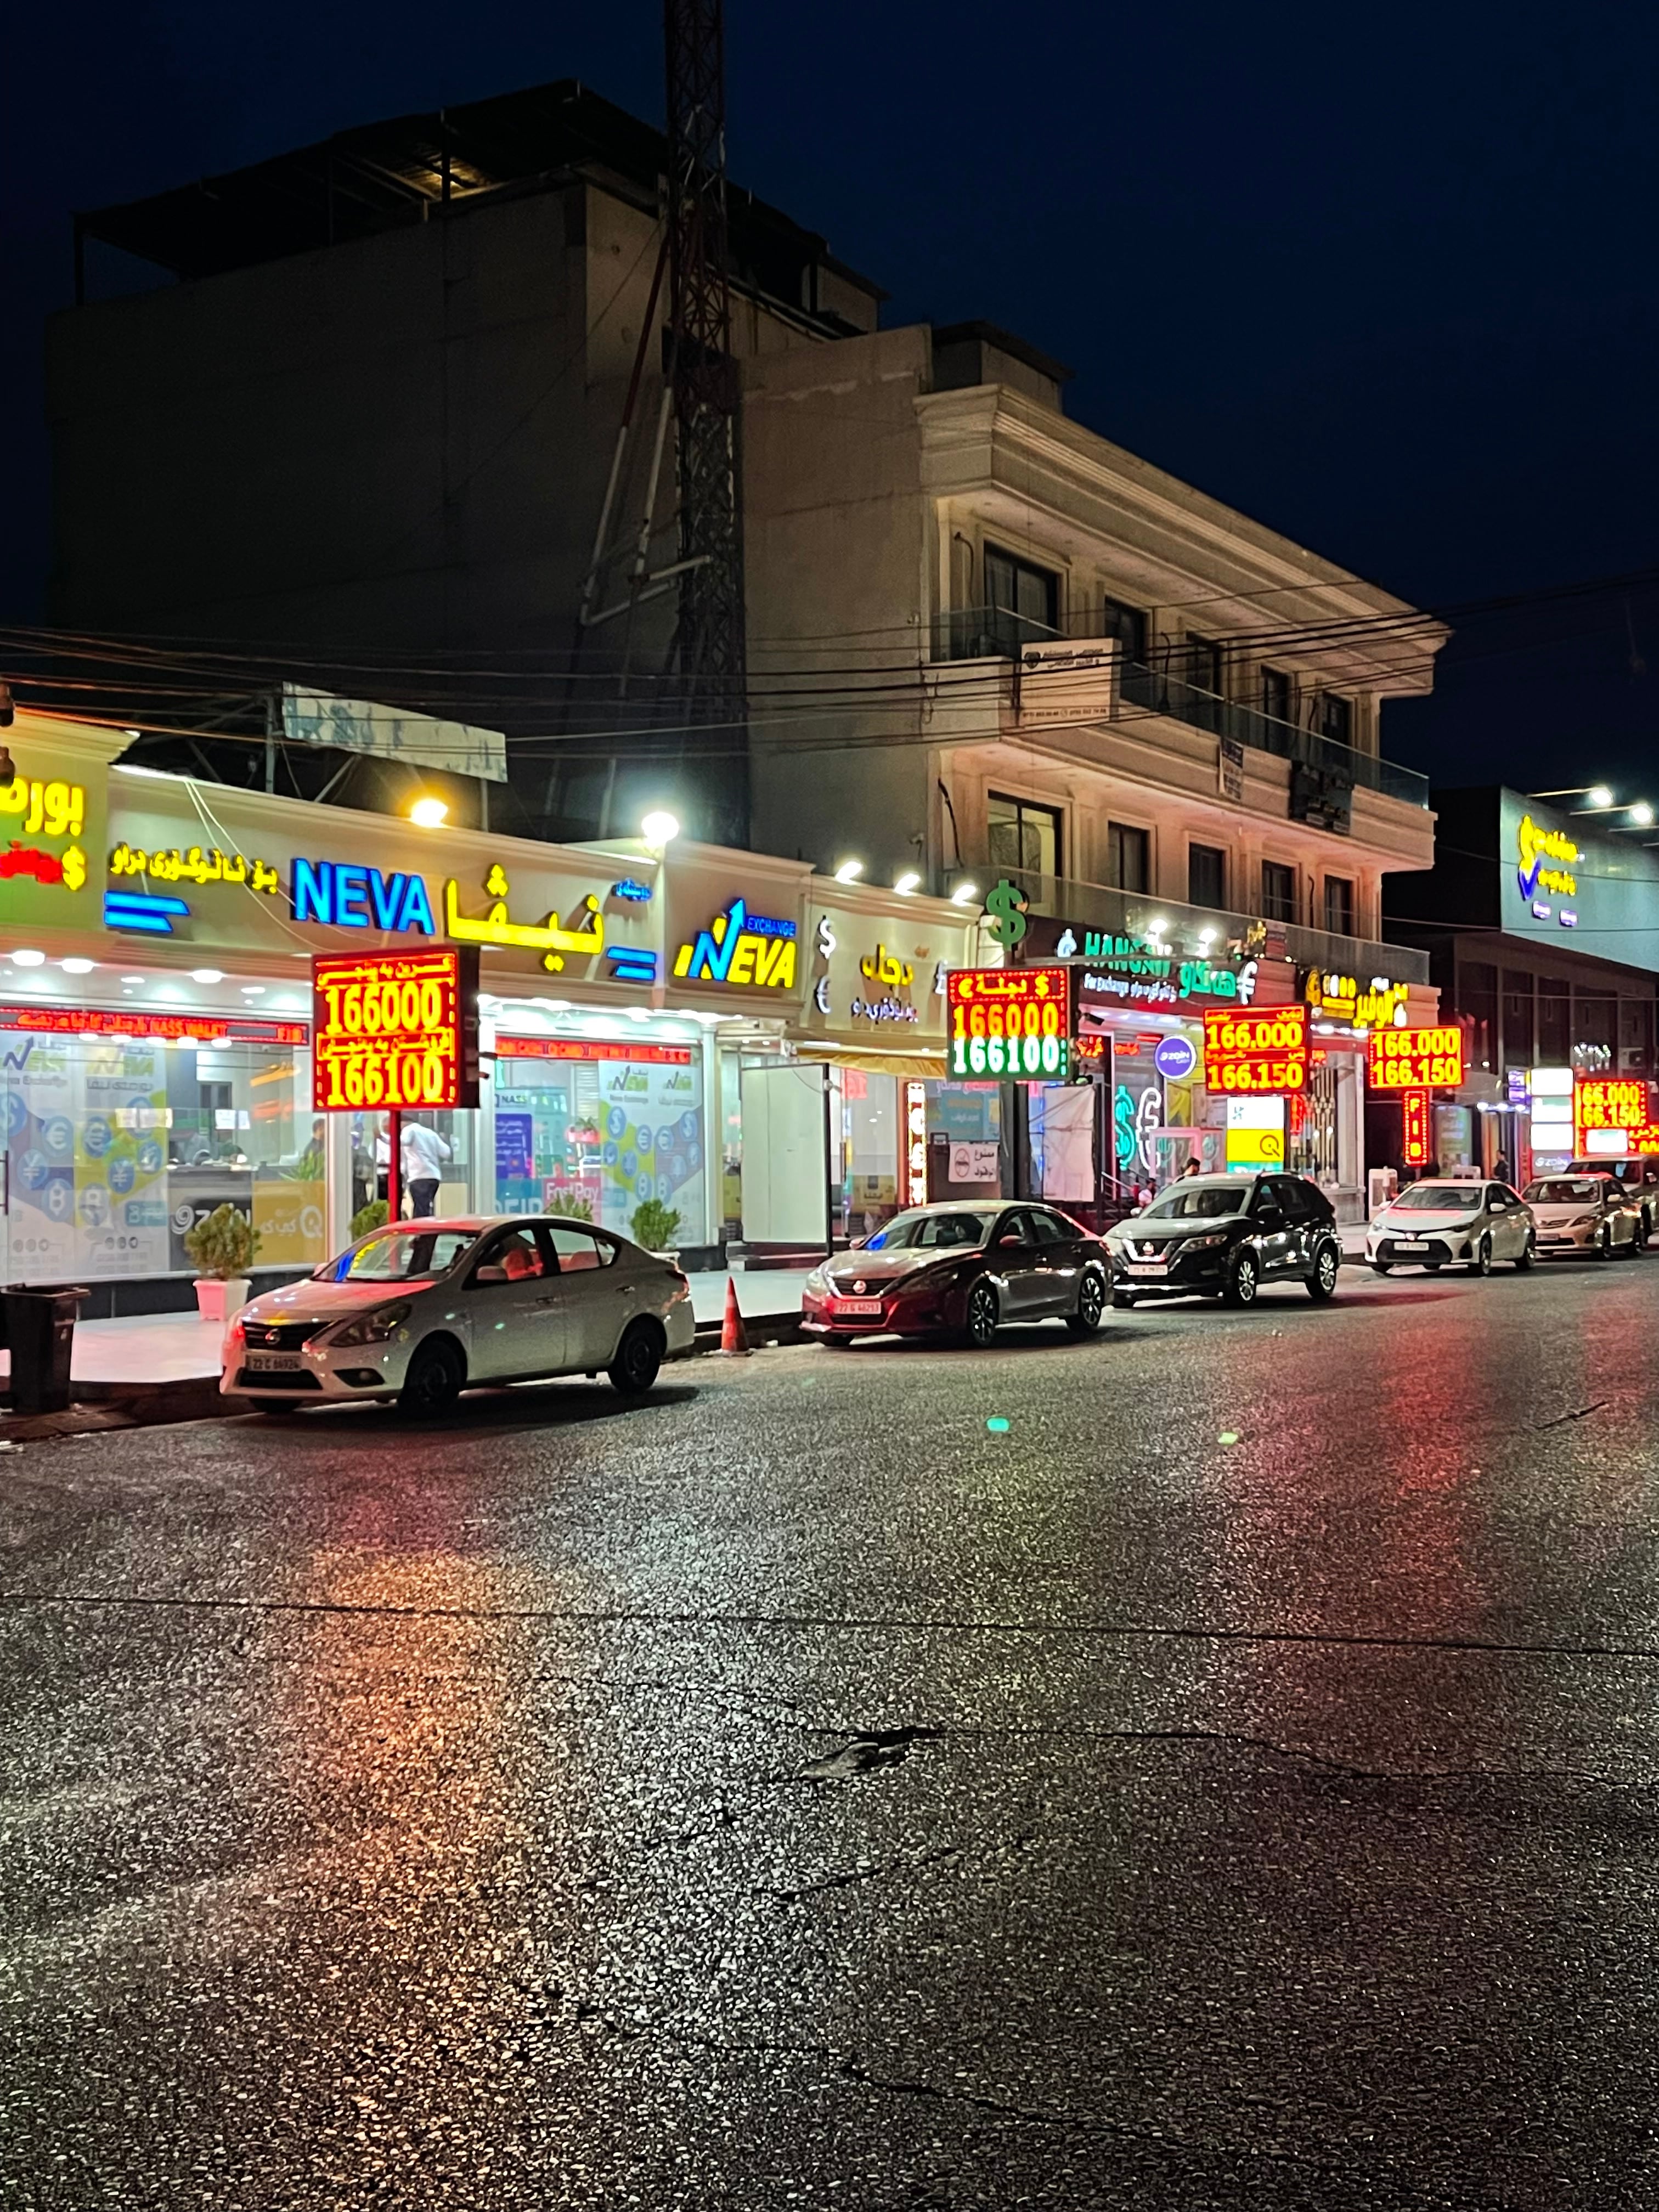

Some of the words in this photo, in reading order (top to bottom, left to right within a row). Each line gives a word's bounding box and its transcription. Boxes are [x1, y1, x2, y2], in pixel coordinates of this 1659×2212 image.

[290, 857, 436, 935] NEVA
[674, 898, 795, 988] NEVA
[747, 916, 795, 937] EXCHANGE
[325, 982, 441, 1035] 166000
[953, 1002, 1059, 1040] 166000
[953, 1035, 1059, 1074] 166100
[1206, 1022, 1303, 1050] 166.000
[1373, 1030, 1459, 1058] 166.000
[328, 1052, 443, 1106] 166100
[1208, 1063, 1304, 1090] 166.150
[1373, 1057, 1459, 1085] 166.150
